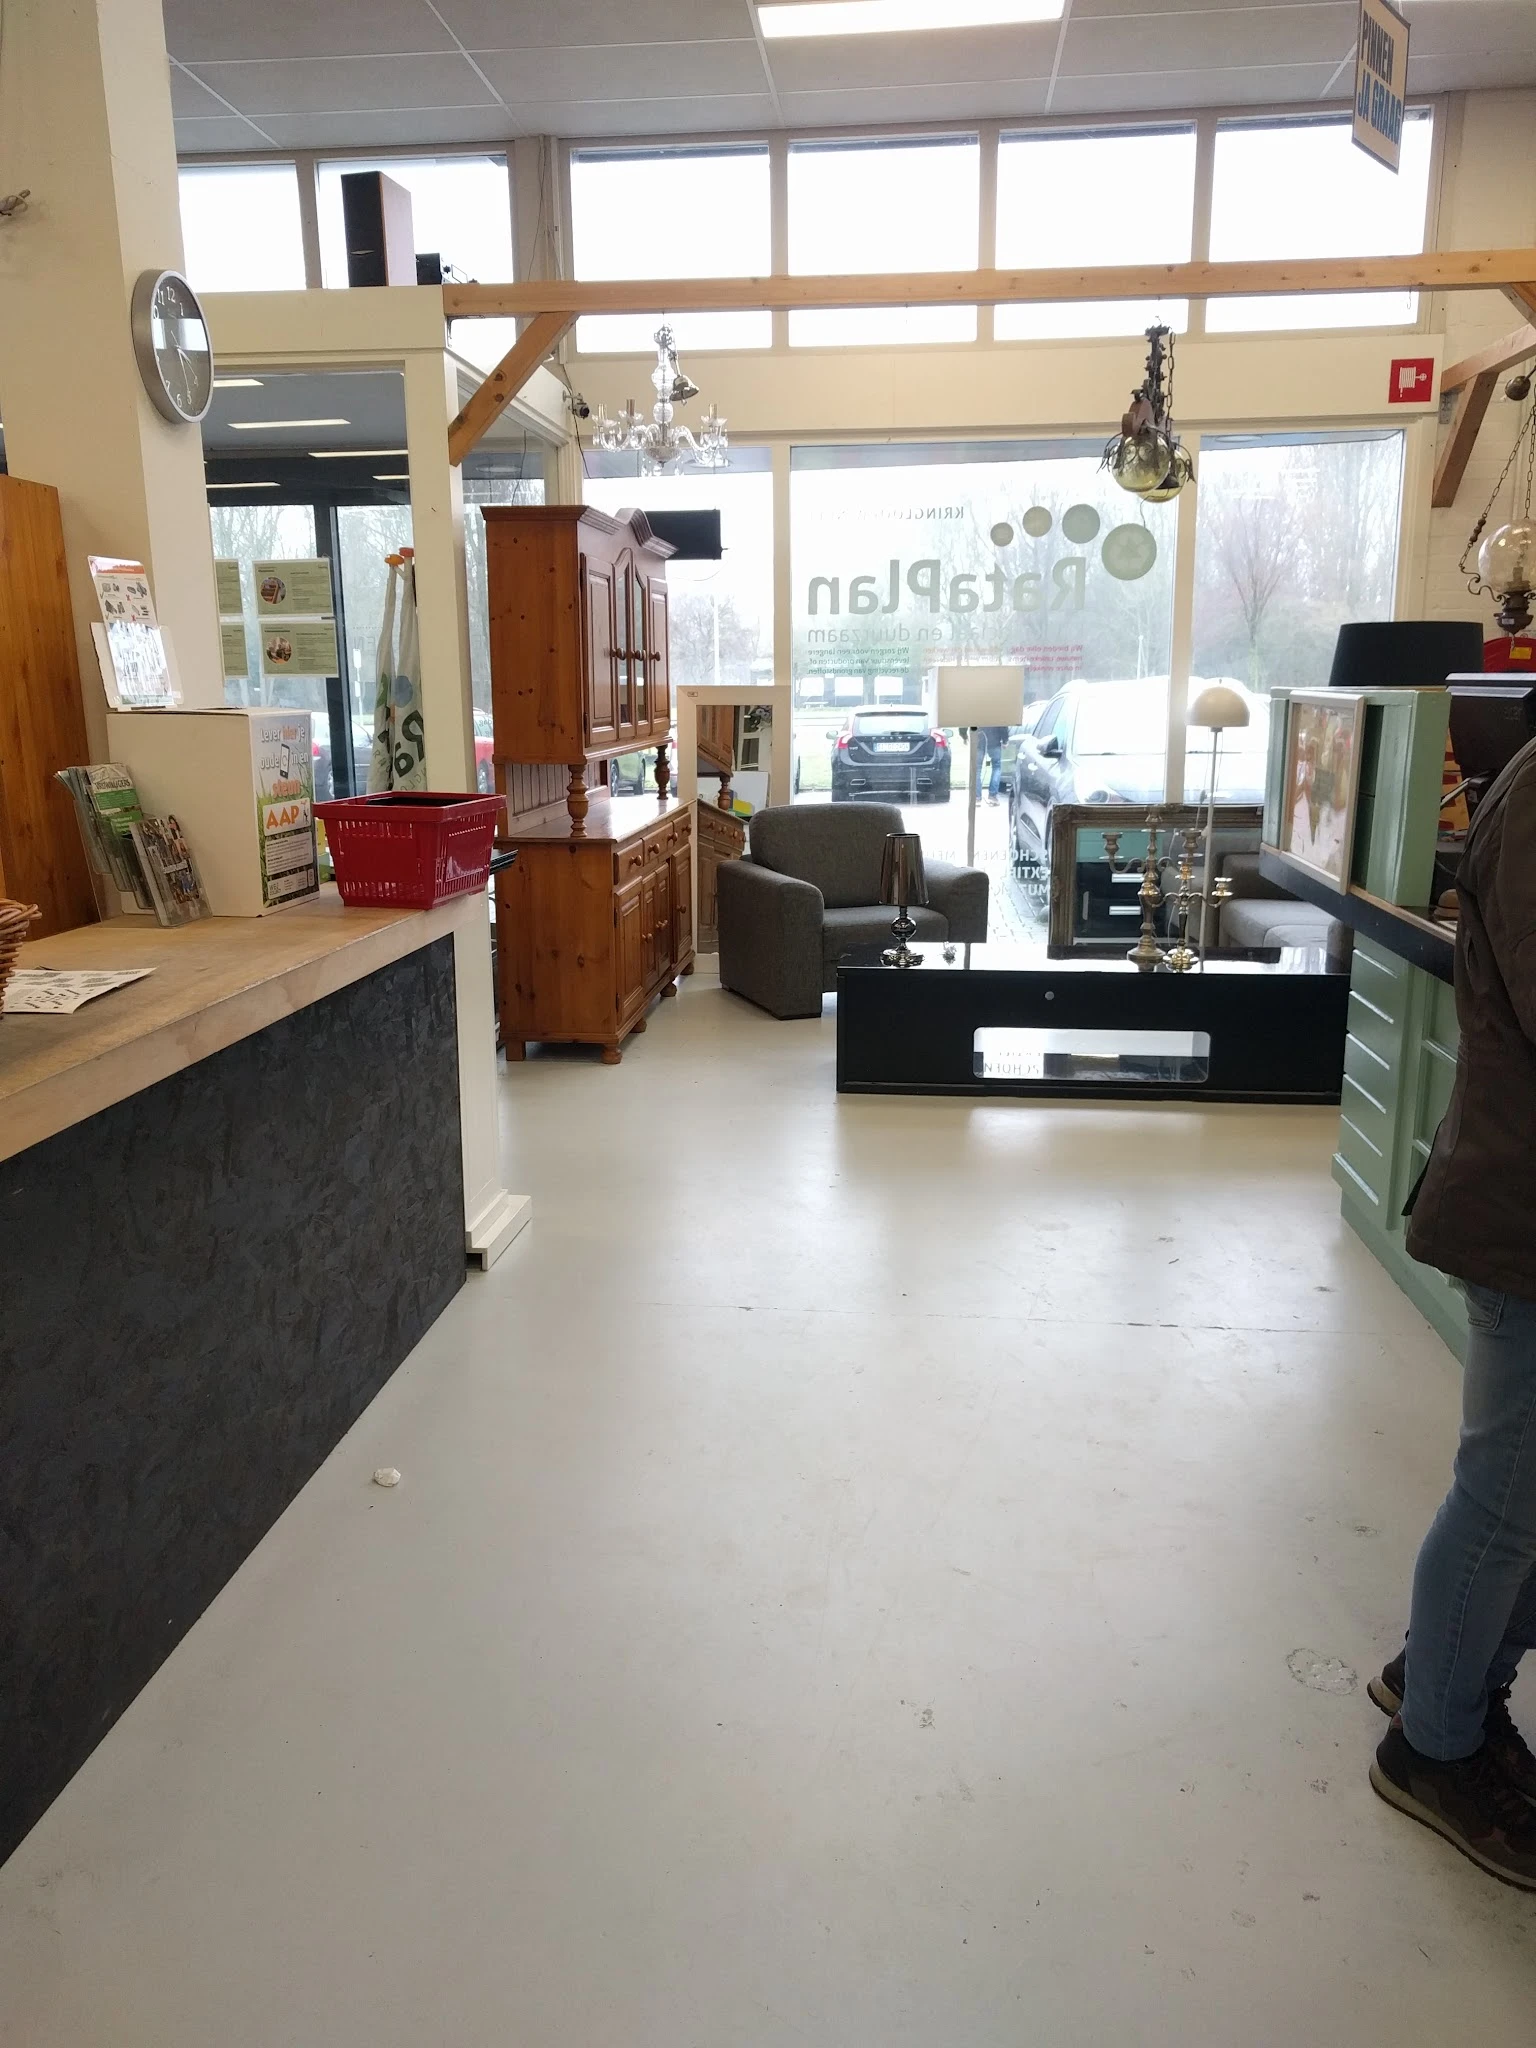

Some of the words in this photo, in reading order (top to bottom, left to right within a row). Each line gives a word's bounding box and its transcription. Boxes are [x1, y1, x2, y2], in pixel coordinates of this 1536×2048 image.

[1361, 10, 1395, 86] PINNEN
[1358, 69, 1370, 123] JA
[1371, 79, 1402, 145] GRAAG
[166, 286, 176, 303] 12
[260, 728, 281, 742] Lever
[298, 726, 306, 742] je
[260, 752, 280, 769] oude
[291, 750, 298, 764] in
[299, 752, 309, 763] en
[272, 779, 301, 799] steun
[266, 804, 300, 830] AAP
